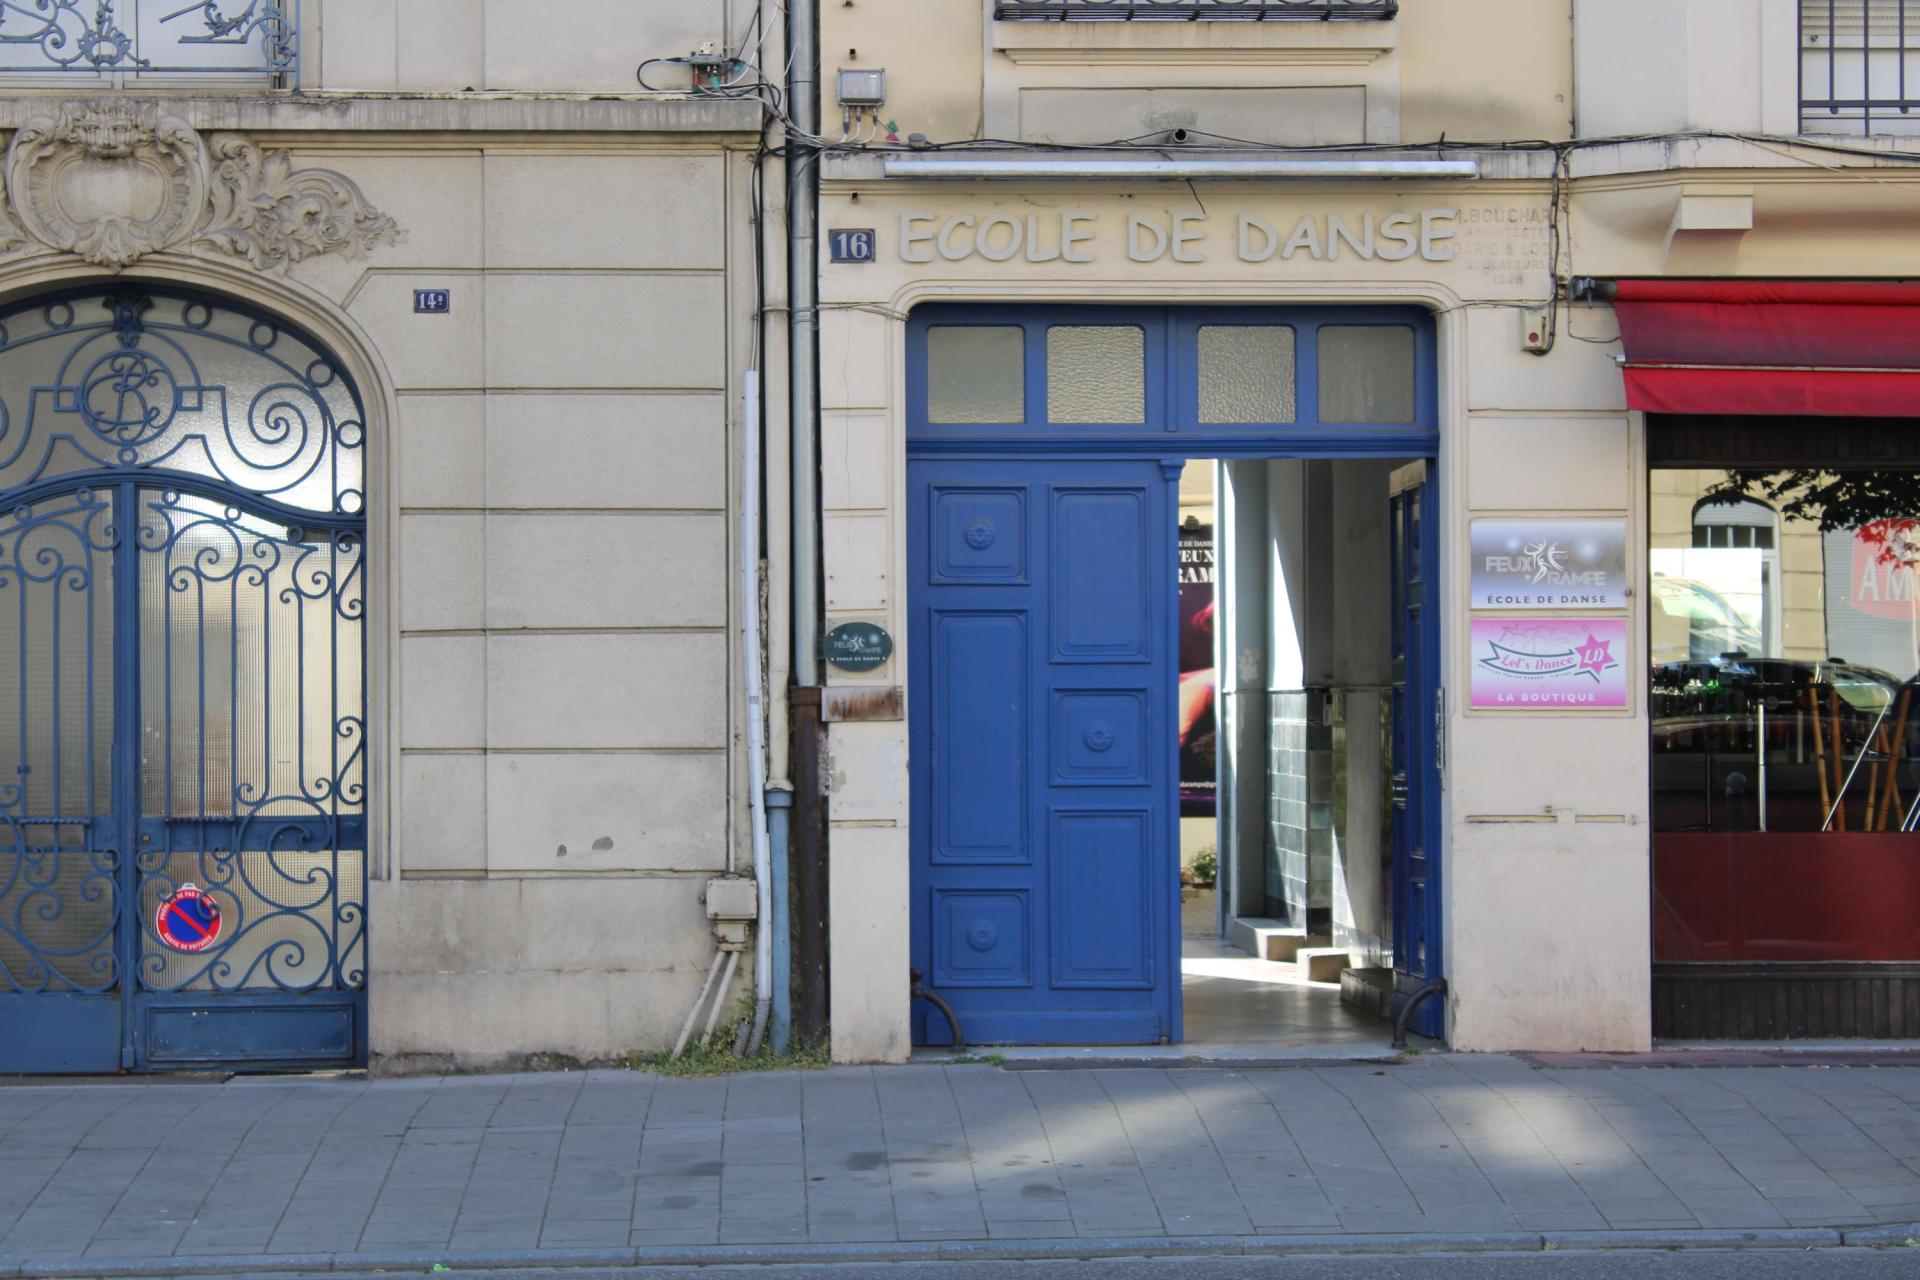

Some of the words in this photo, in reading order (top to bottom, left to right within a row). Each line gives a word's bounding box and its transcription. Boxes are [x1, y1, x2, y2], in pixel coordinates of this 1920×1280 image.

[900, 212, 1097, 263] ECOLE
[1128, 213, 1207, 263] DE
[1237, 209, 1457, 263] DANSE
[837, 232, 869, 259] 16
[1537, 595, 1554, 604] DE
[1560, 595, 1606, 604] DANSE
[1536, 656, 1574, 670] Dance
[1498, 692, 1515, 702] LA
[1521, 692, 1596, 703] BOUTIQUE
